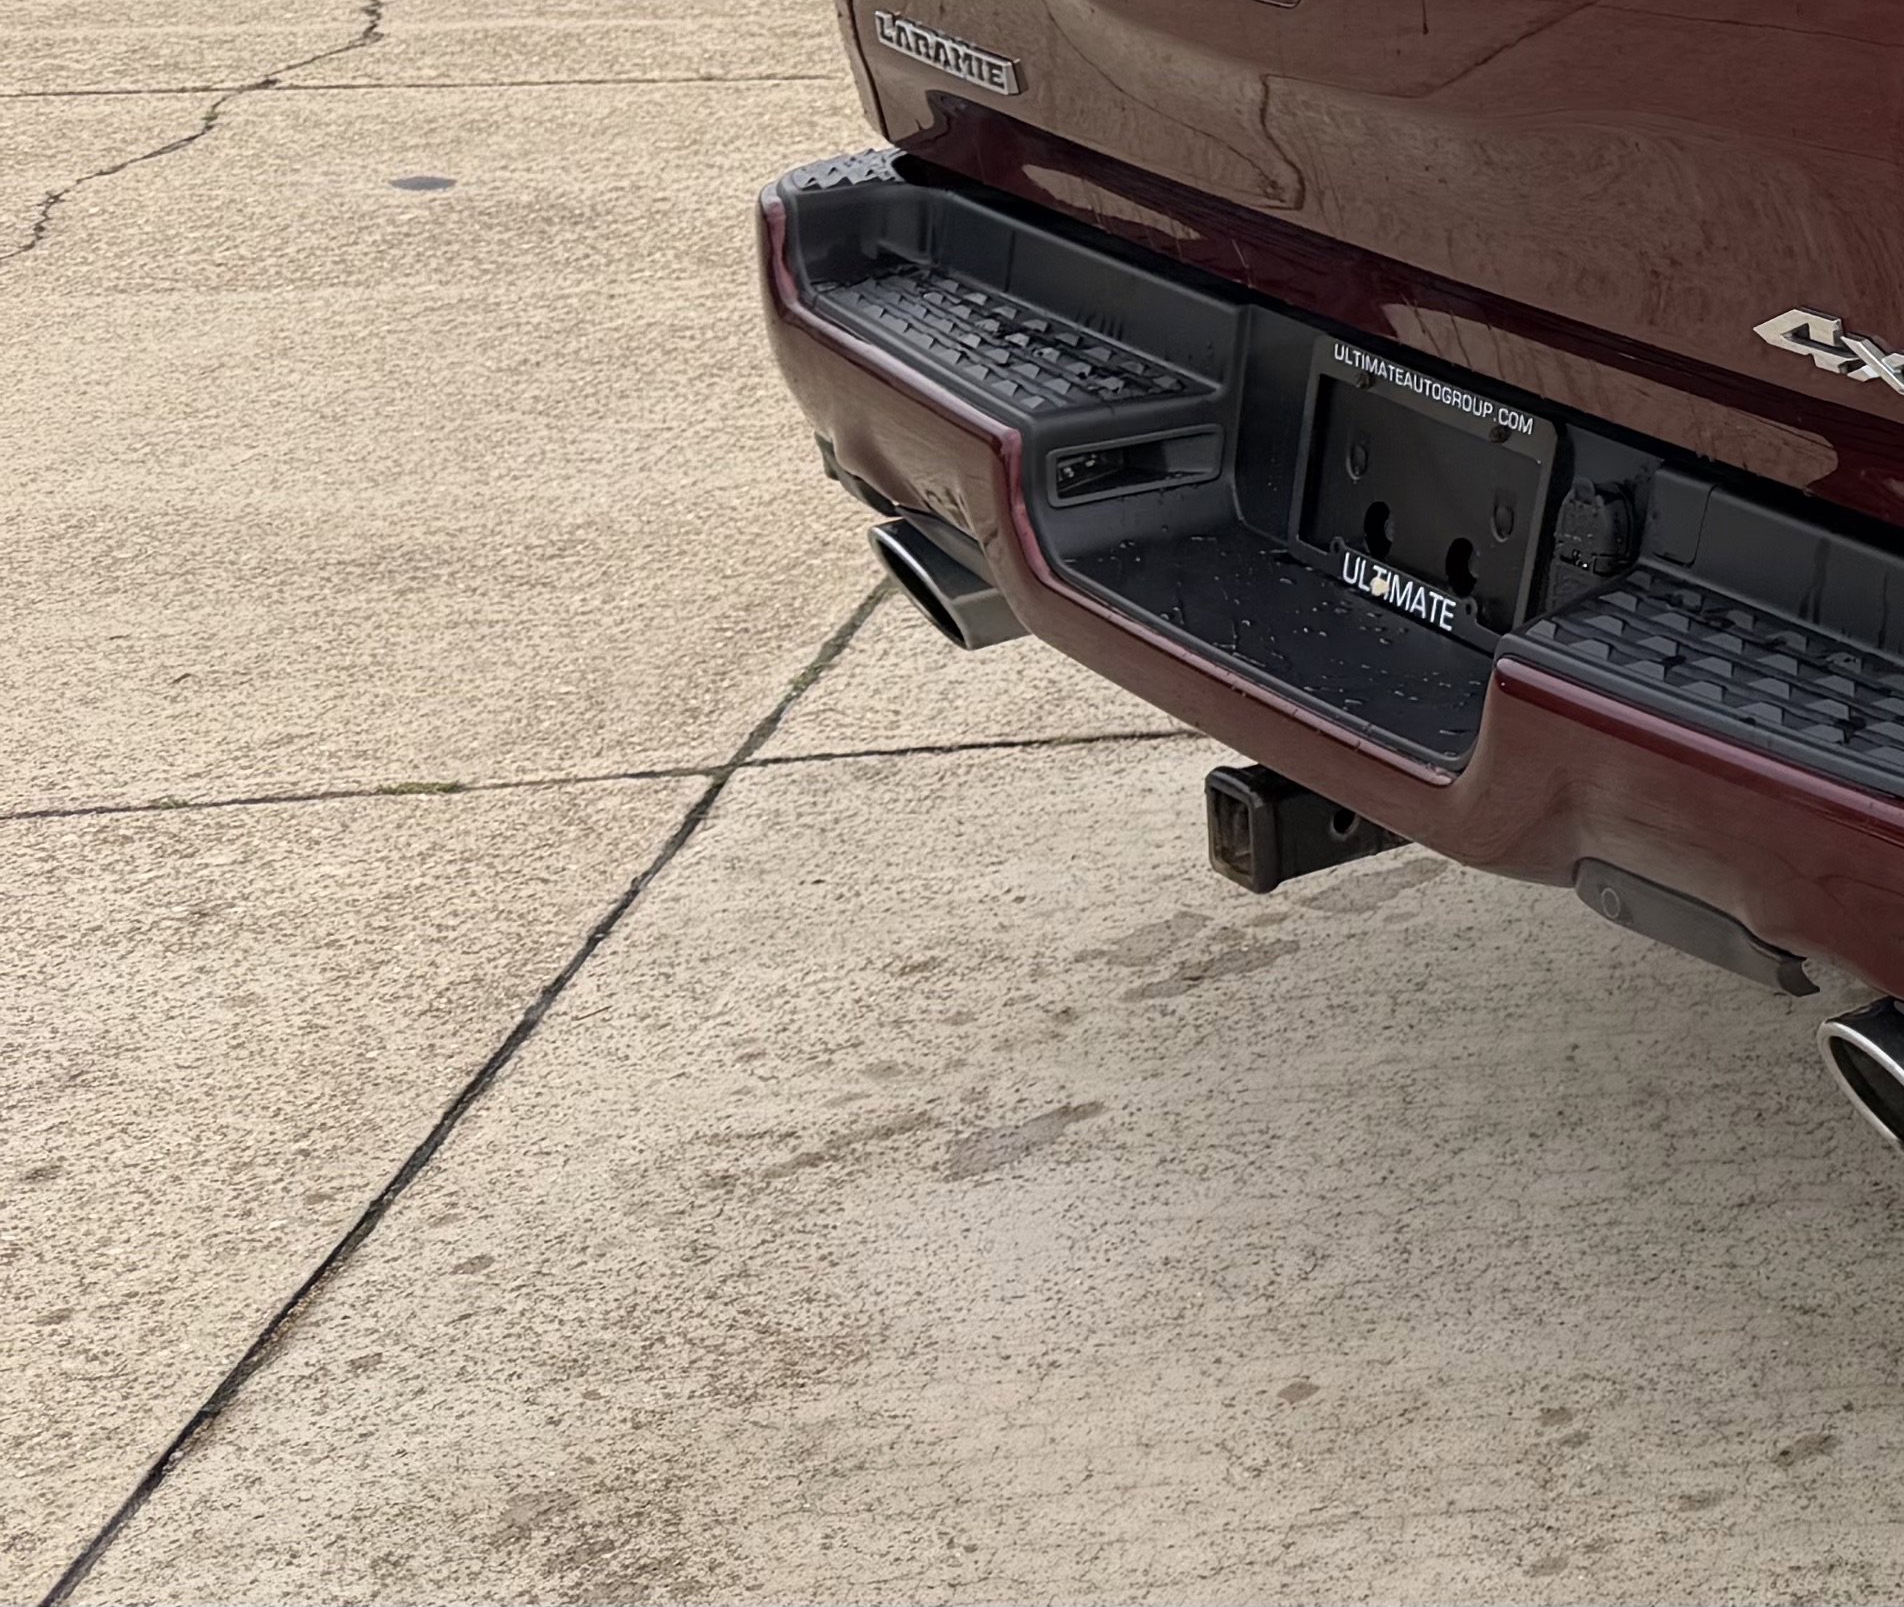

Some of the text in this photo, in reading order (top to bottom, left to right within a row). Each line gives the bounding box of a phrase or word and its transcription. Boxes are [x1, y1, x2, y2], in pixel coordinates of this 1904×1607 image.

[874, 9, 1021, 96] LARAMIE
[1333, 343, 1534, 436] ULTIMATEAUTOGROUP.COM
[1342, 552, 1457, 632] ULTIMATE
